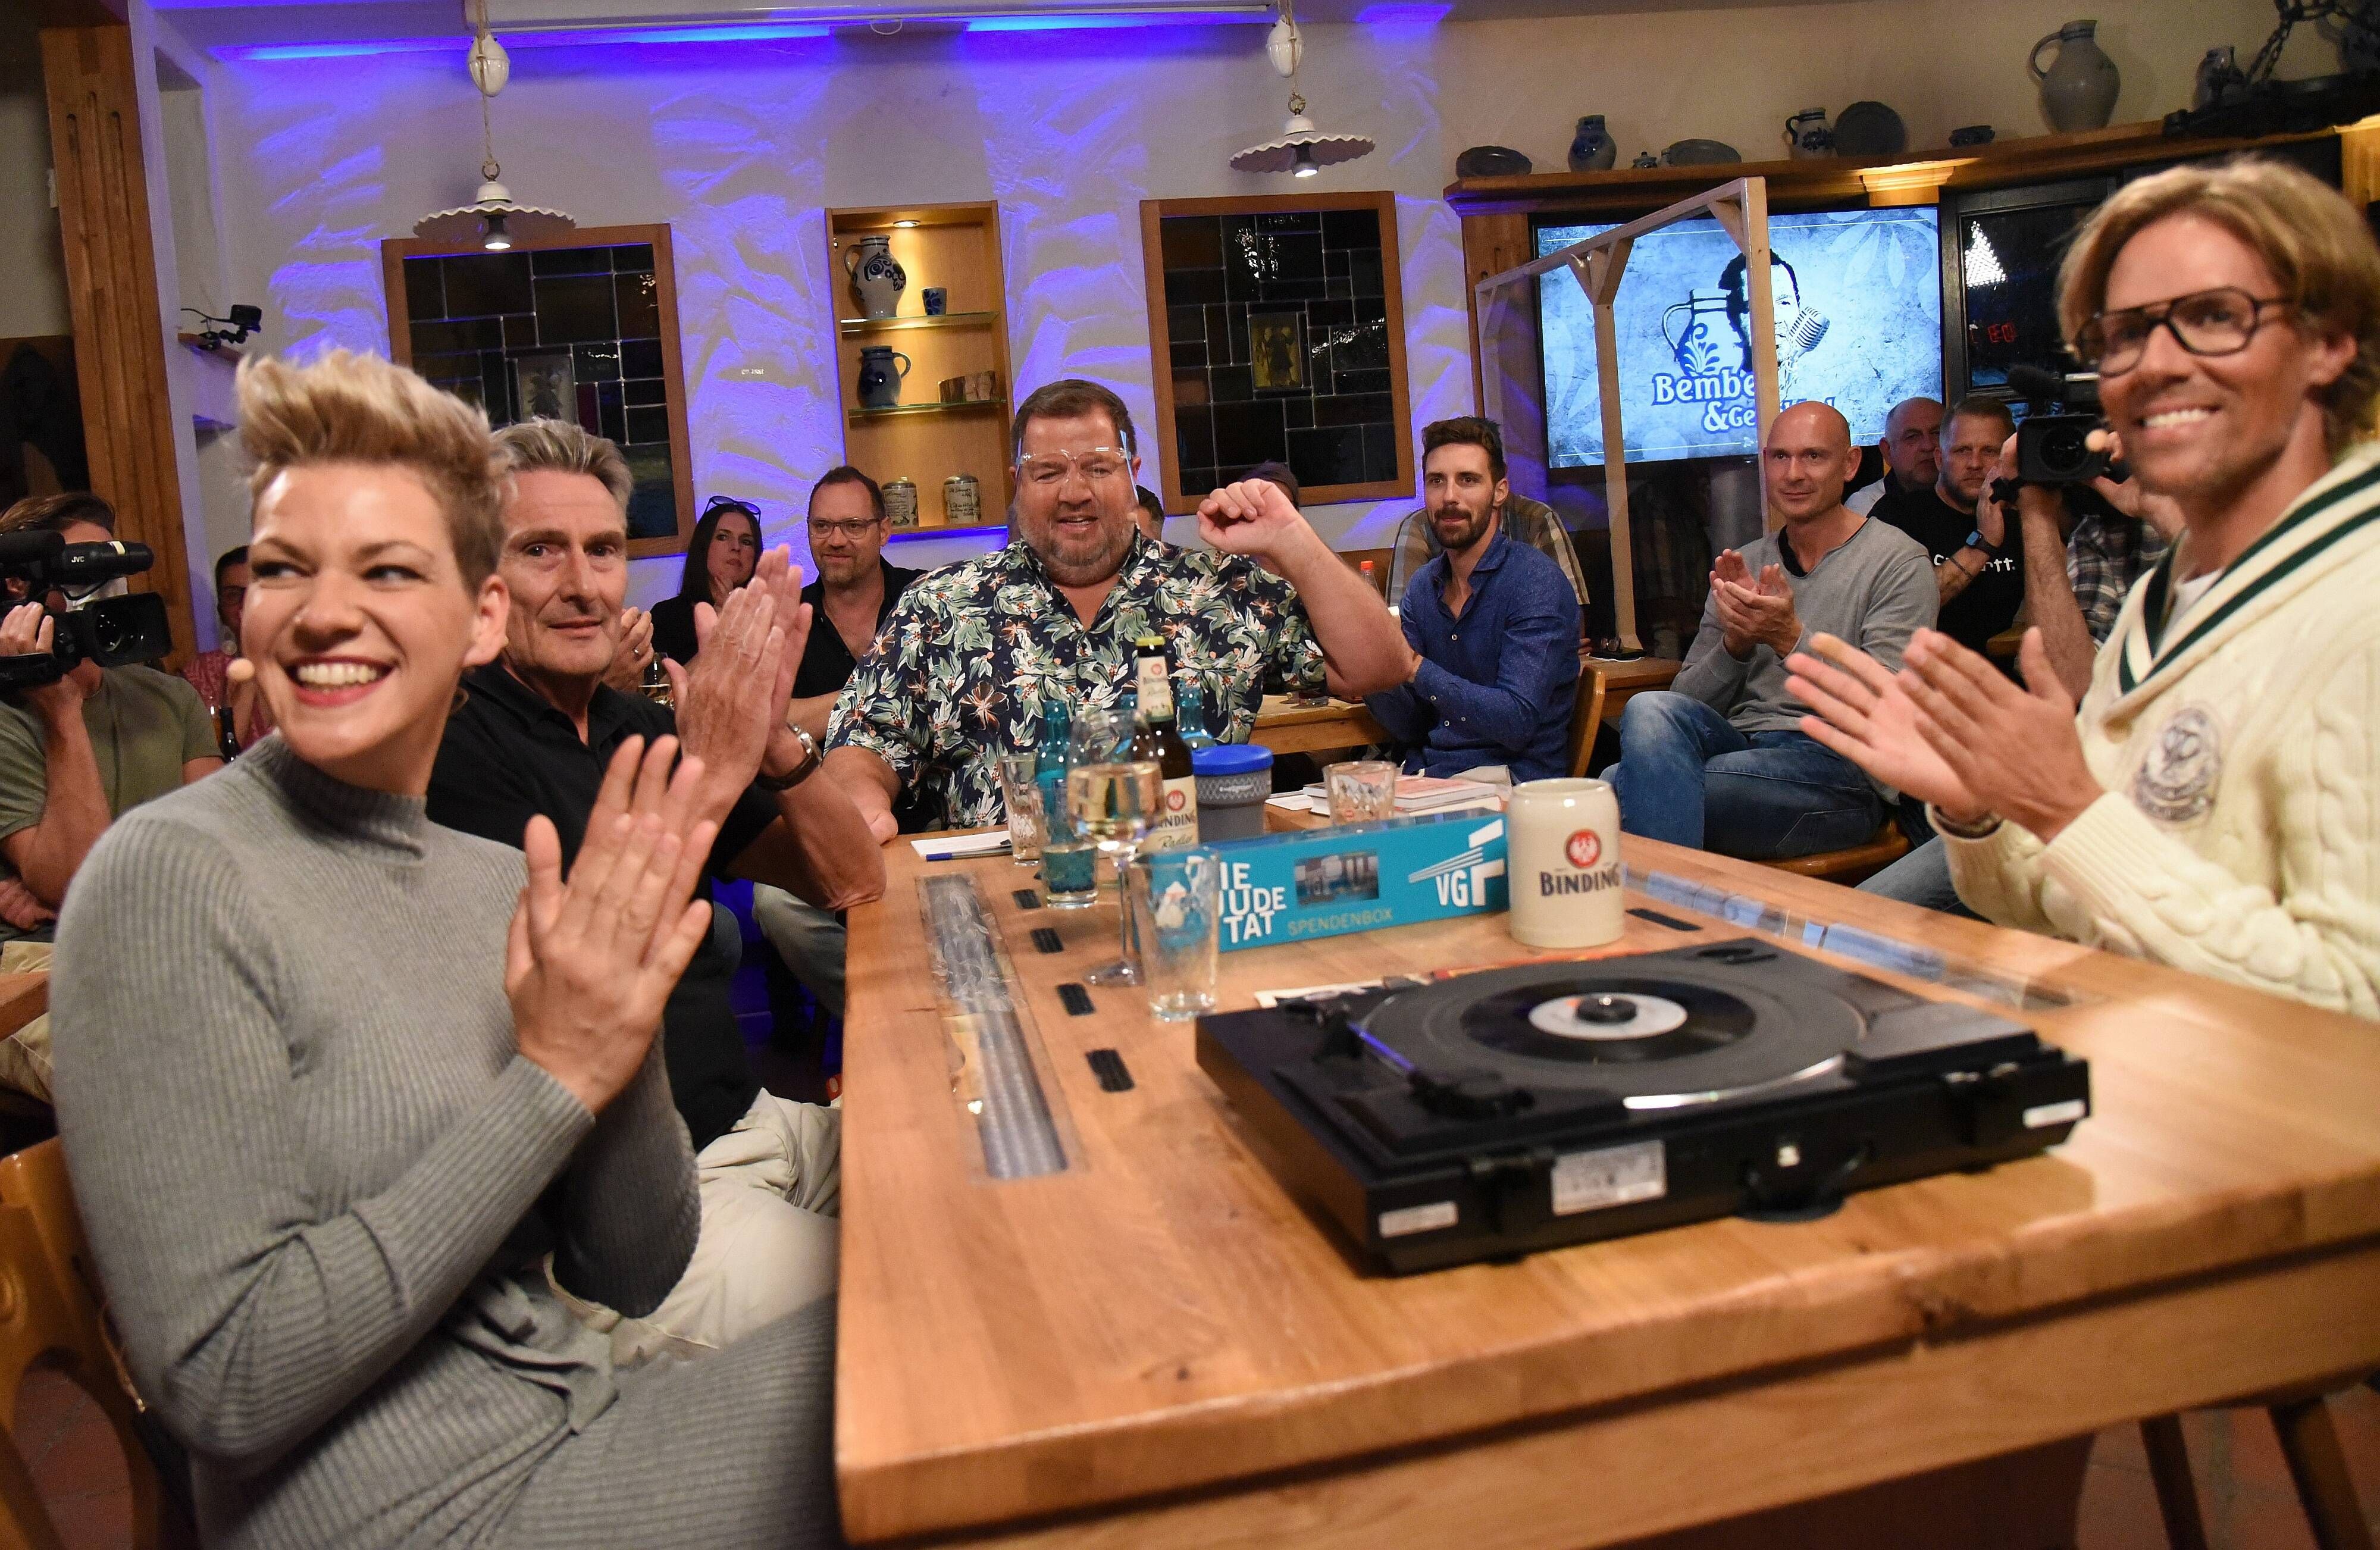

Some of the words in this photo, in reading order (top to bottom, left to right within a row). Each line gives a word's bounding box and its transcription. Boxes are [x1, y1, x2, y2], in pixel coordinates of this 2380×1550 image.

[1652, 367, 1755, 405] Bembe
[1703, 400, 1755, 433] &Ge
[1540, 863, 1620, 897] BINDING
[1223, 910, 1274, 943] TAT
[1287, 908, 1393, 937] SPENDENBOX
